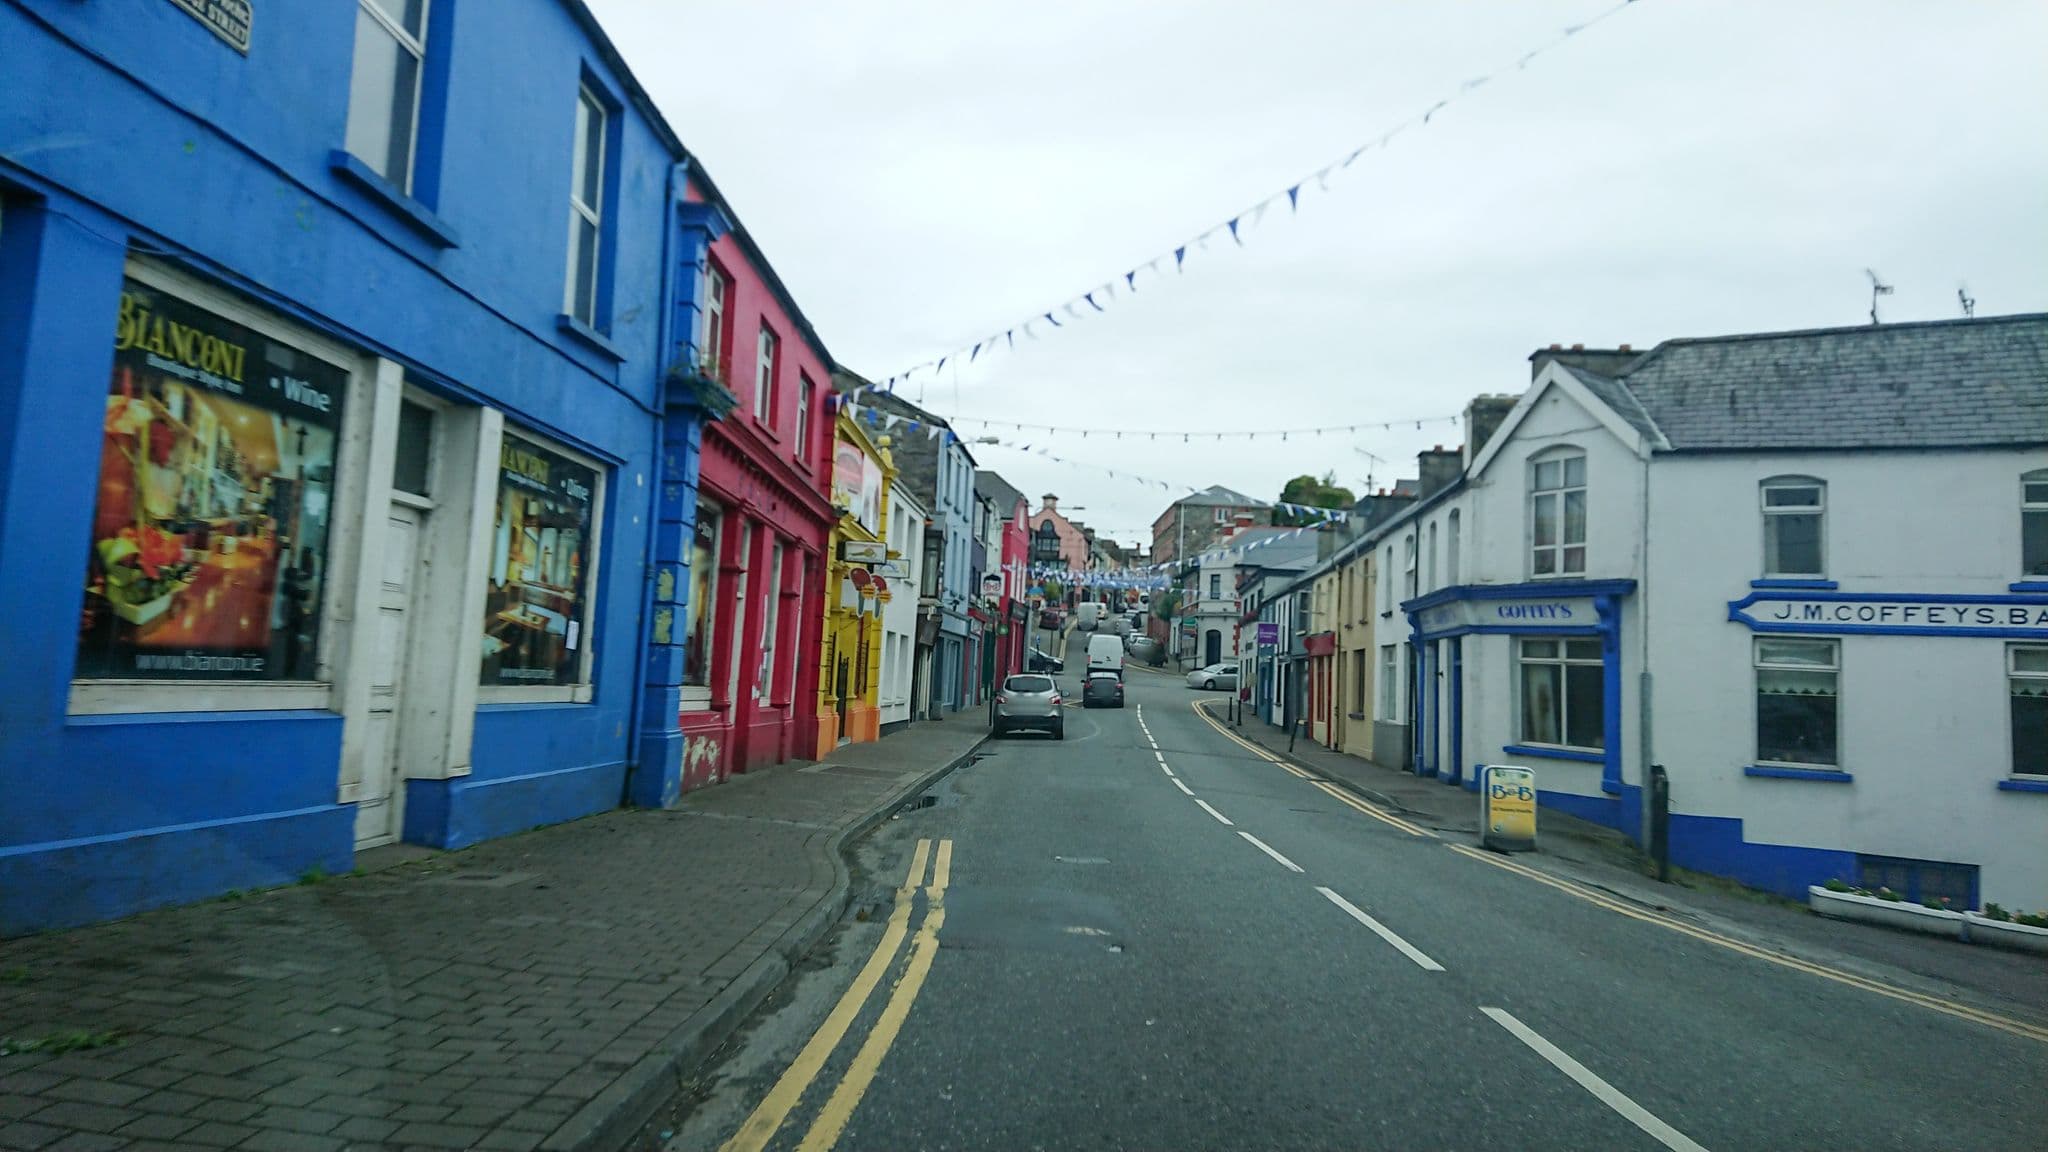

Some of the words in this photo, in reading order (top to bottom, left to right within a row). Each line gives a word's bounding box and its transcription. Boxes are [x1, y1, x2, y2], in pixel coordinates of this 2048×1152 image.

[115, 293, 246, 383] BIANCONI
[283, 375, 332, 413] Wine
[501, 443, 549, 486] IANCONI
